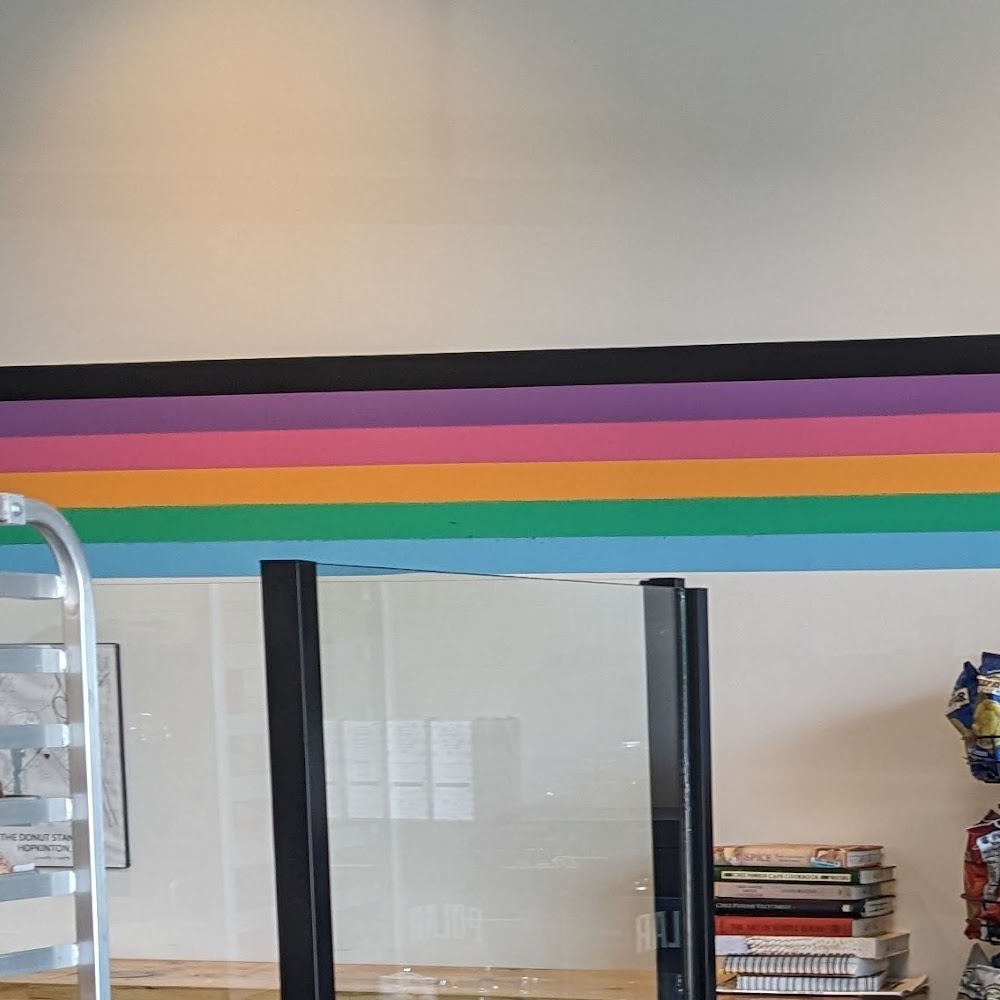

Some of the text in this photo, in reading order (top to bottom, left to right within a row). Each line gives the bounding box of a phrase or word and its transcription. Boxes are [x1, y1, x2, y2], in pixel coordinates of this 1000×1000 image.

[0, 833, 73, 841] THE DONUT STAN
